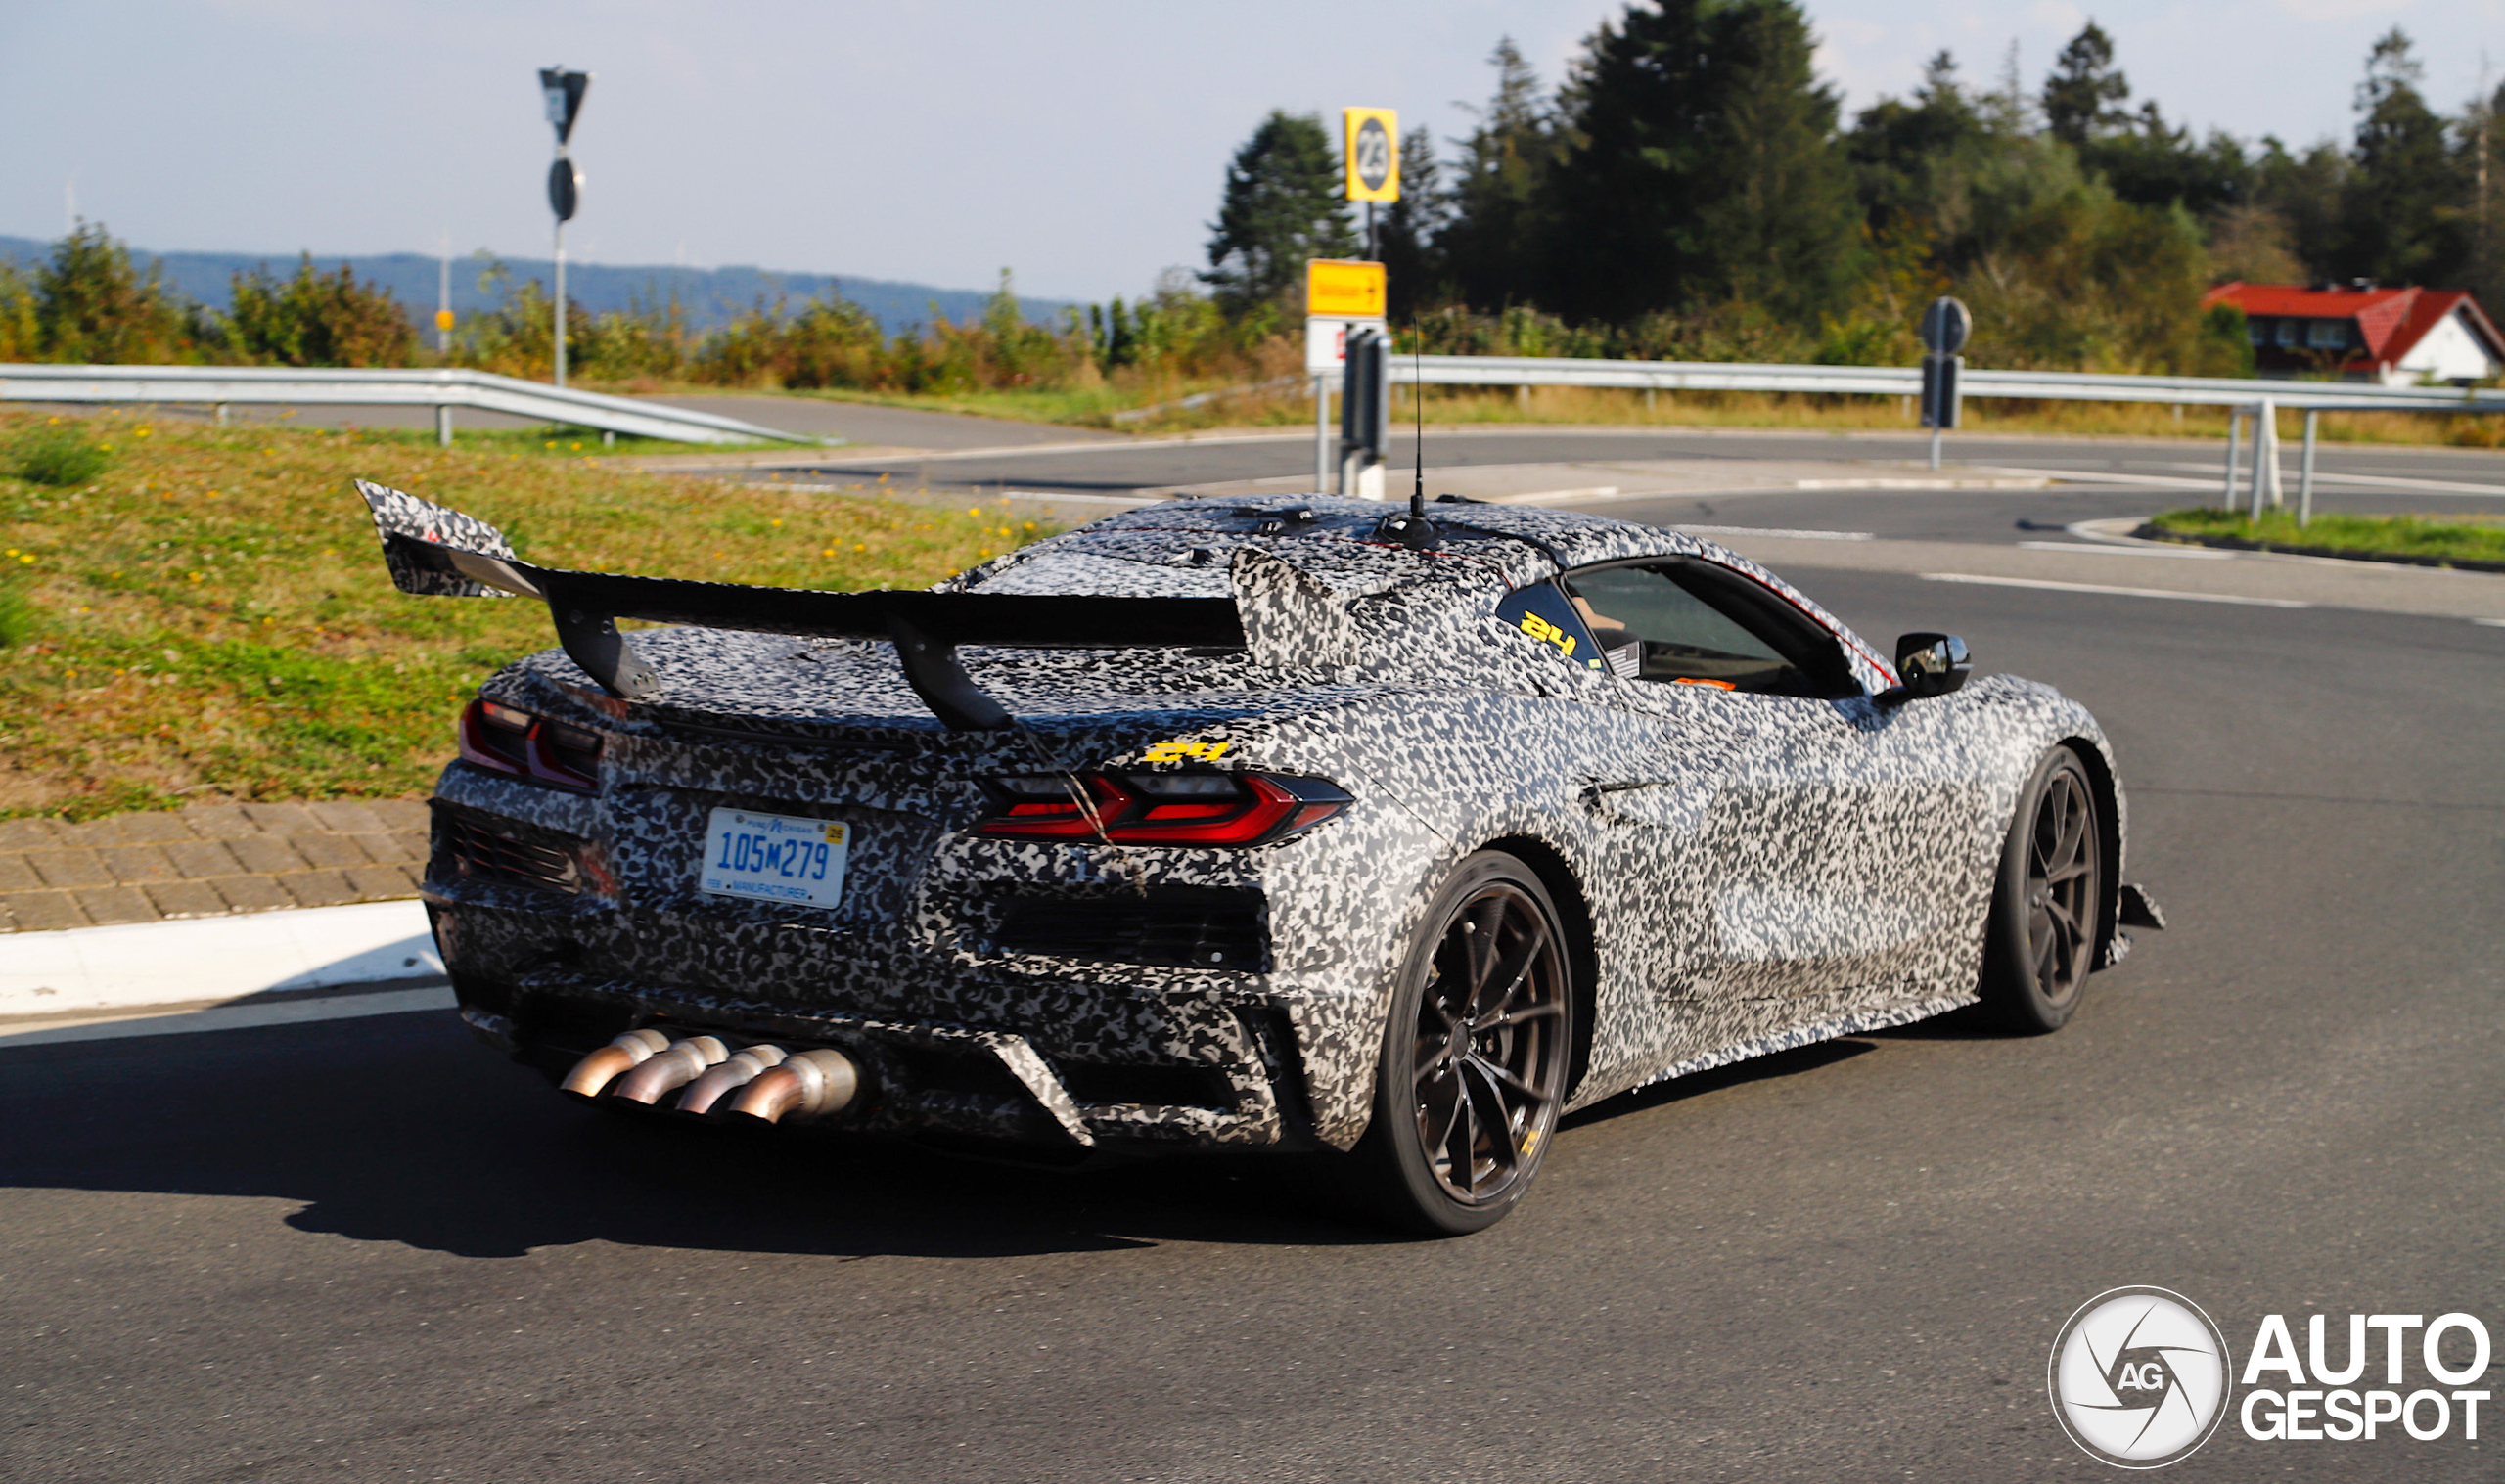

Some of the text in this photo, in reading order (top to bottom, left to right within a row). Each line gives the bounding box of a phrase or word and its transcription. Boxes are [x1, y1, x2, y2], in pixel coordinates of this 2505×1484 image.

[1356, 128, 1389, 179] 23
[1520, 609, 1577, 656] 24
[1143, 742, 1229, 762] 24
[717, 832, 829, 880] 105M279
[733, 879, 808, 899] MANUFACTURER
